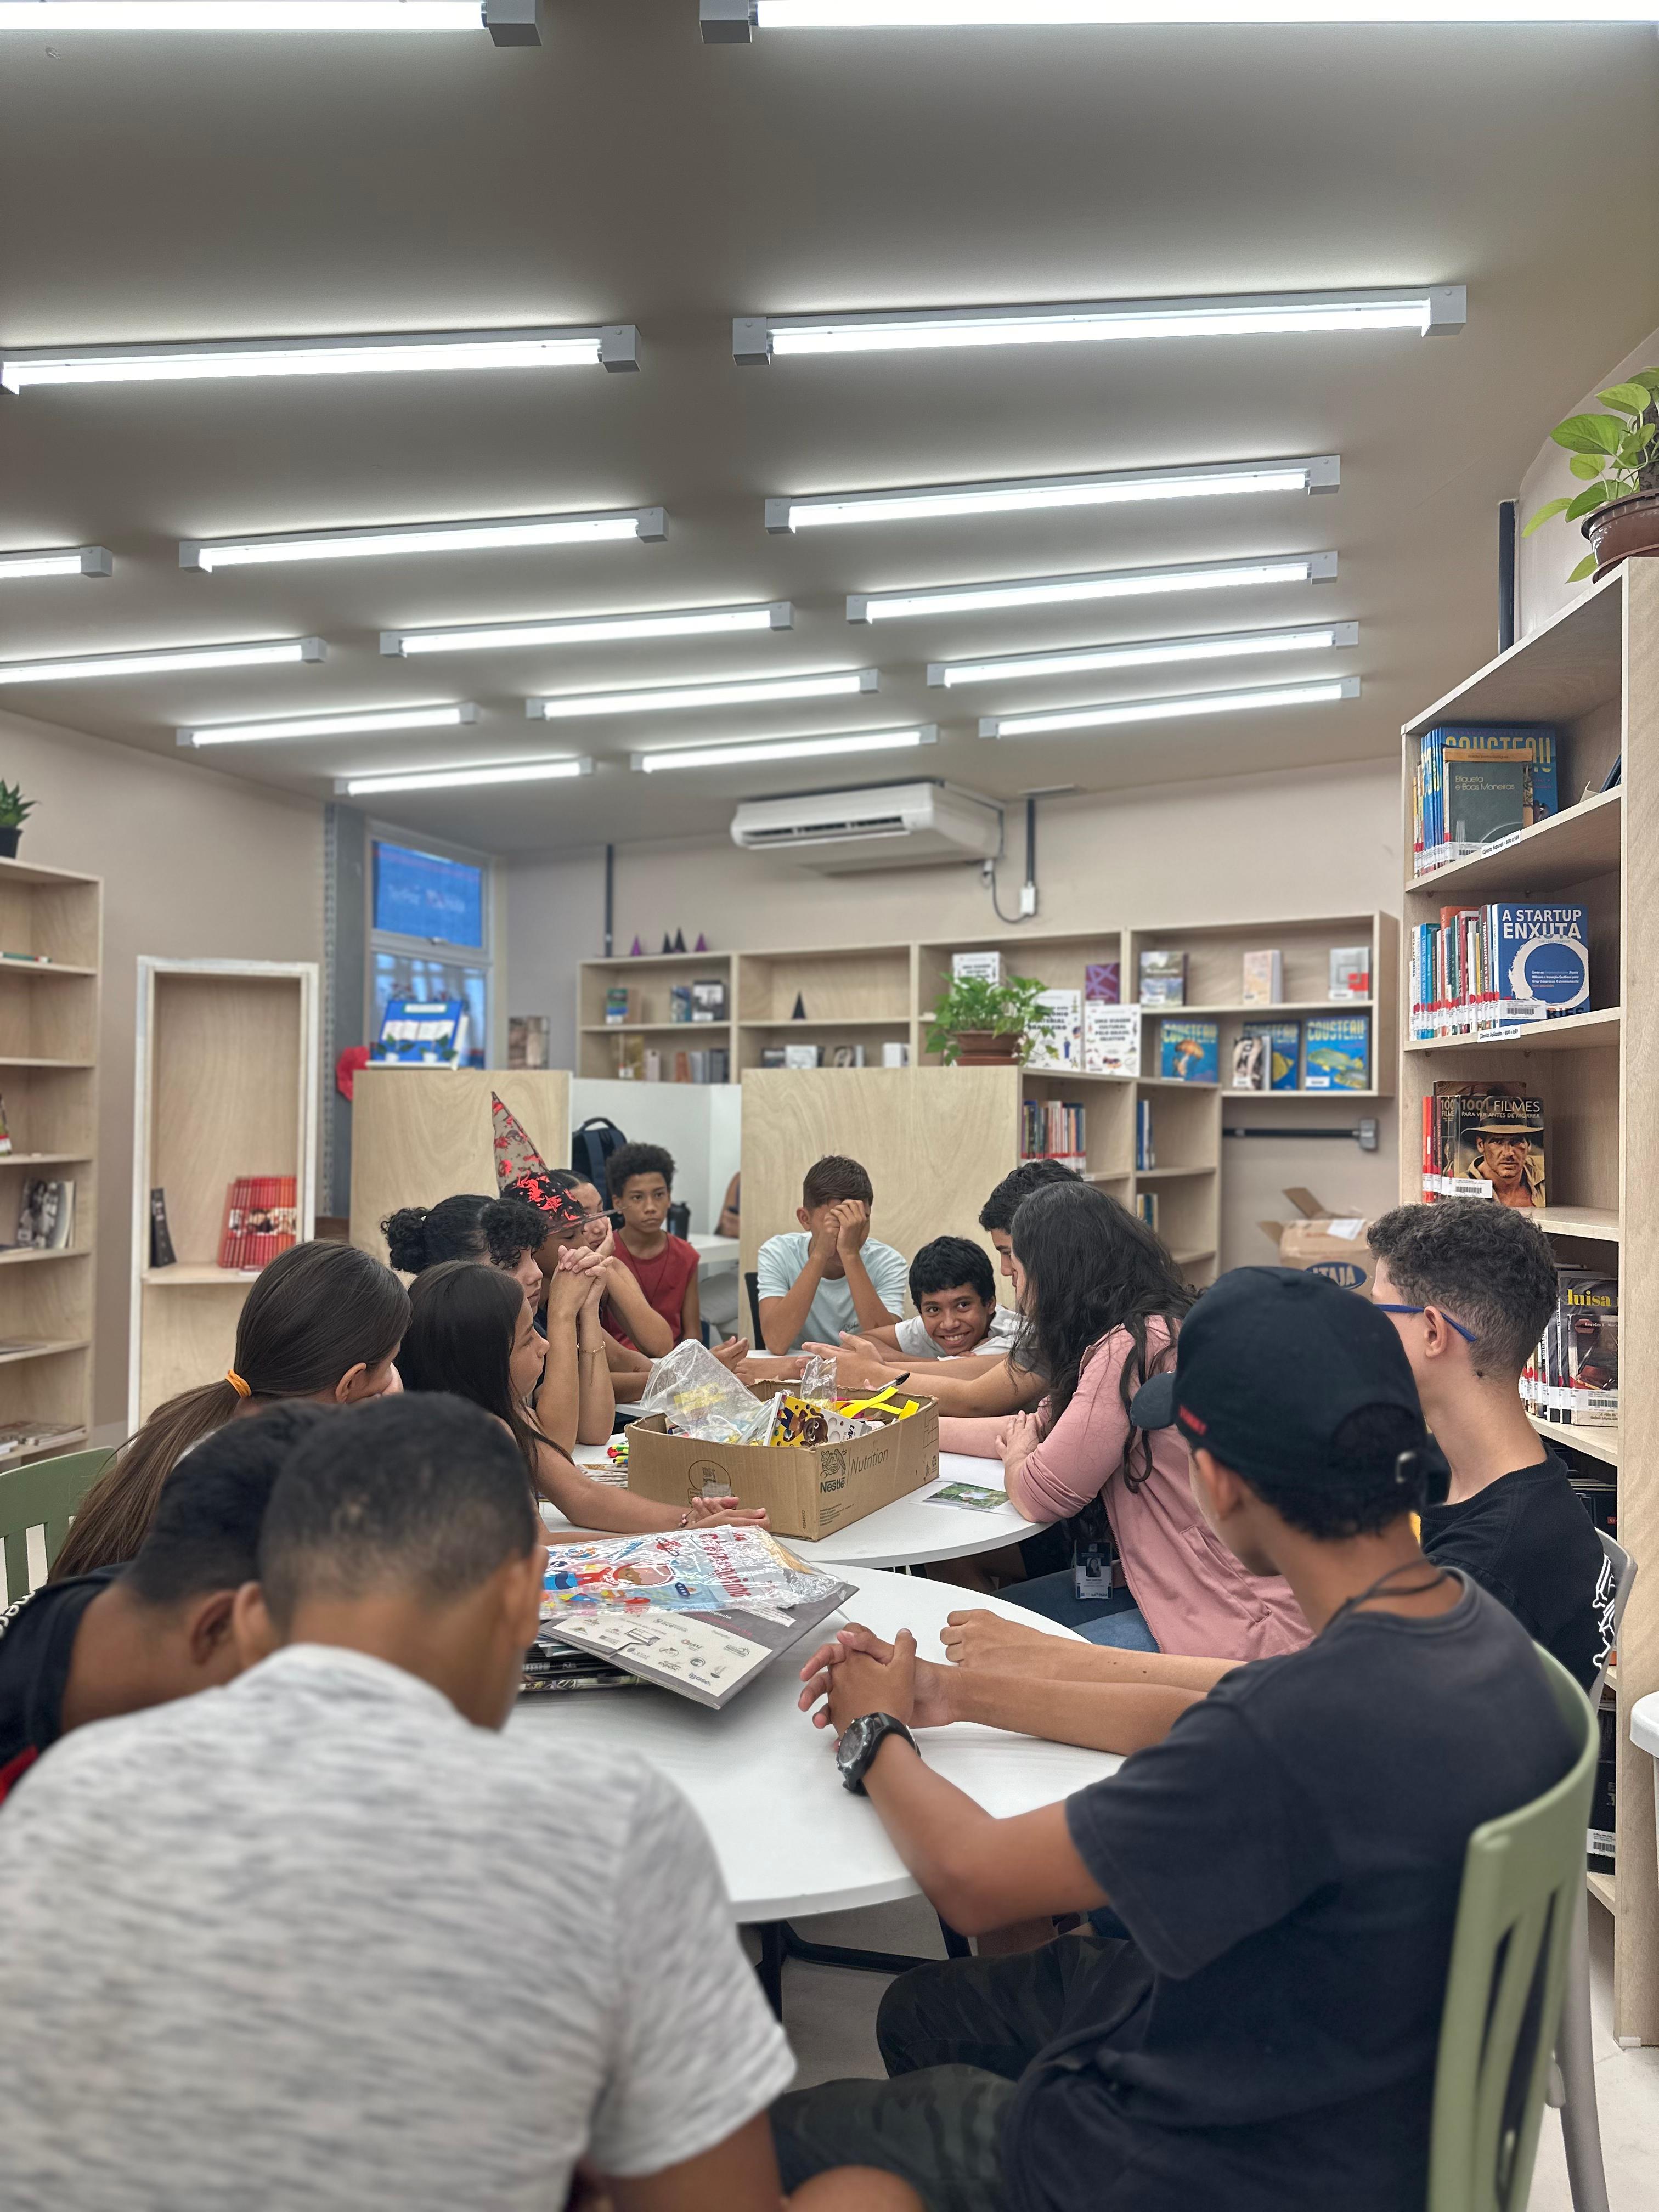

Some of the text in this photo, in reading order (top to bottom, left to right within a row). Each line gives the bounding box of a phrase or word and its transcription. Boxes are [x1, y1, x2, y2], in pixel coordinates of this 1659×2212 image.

[1455, 775, 1483, 784] Etiqueta
[1502, 909, 1582, 922] A STARTUP
[1503, 923, 1582, 939] ENXUTA
[1494, 1100, 1541, 1113] FILMES
[1567, 1289, 1611, 1307] luisa
[851, 1448, 889, 1476] Nutrition
